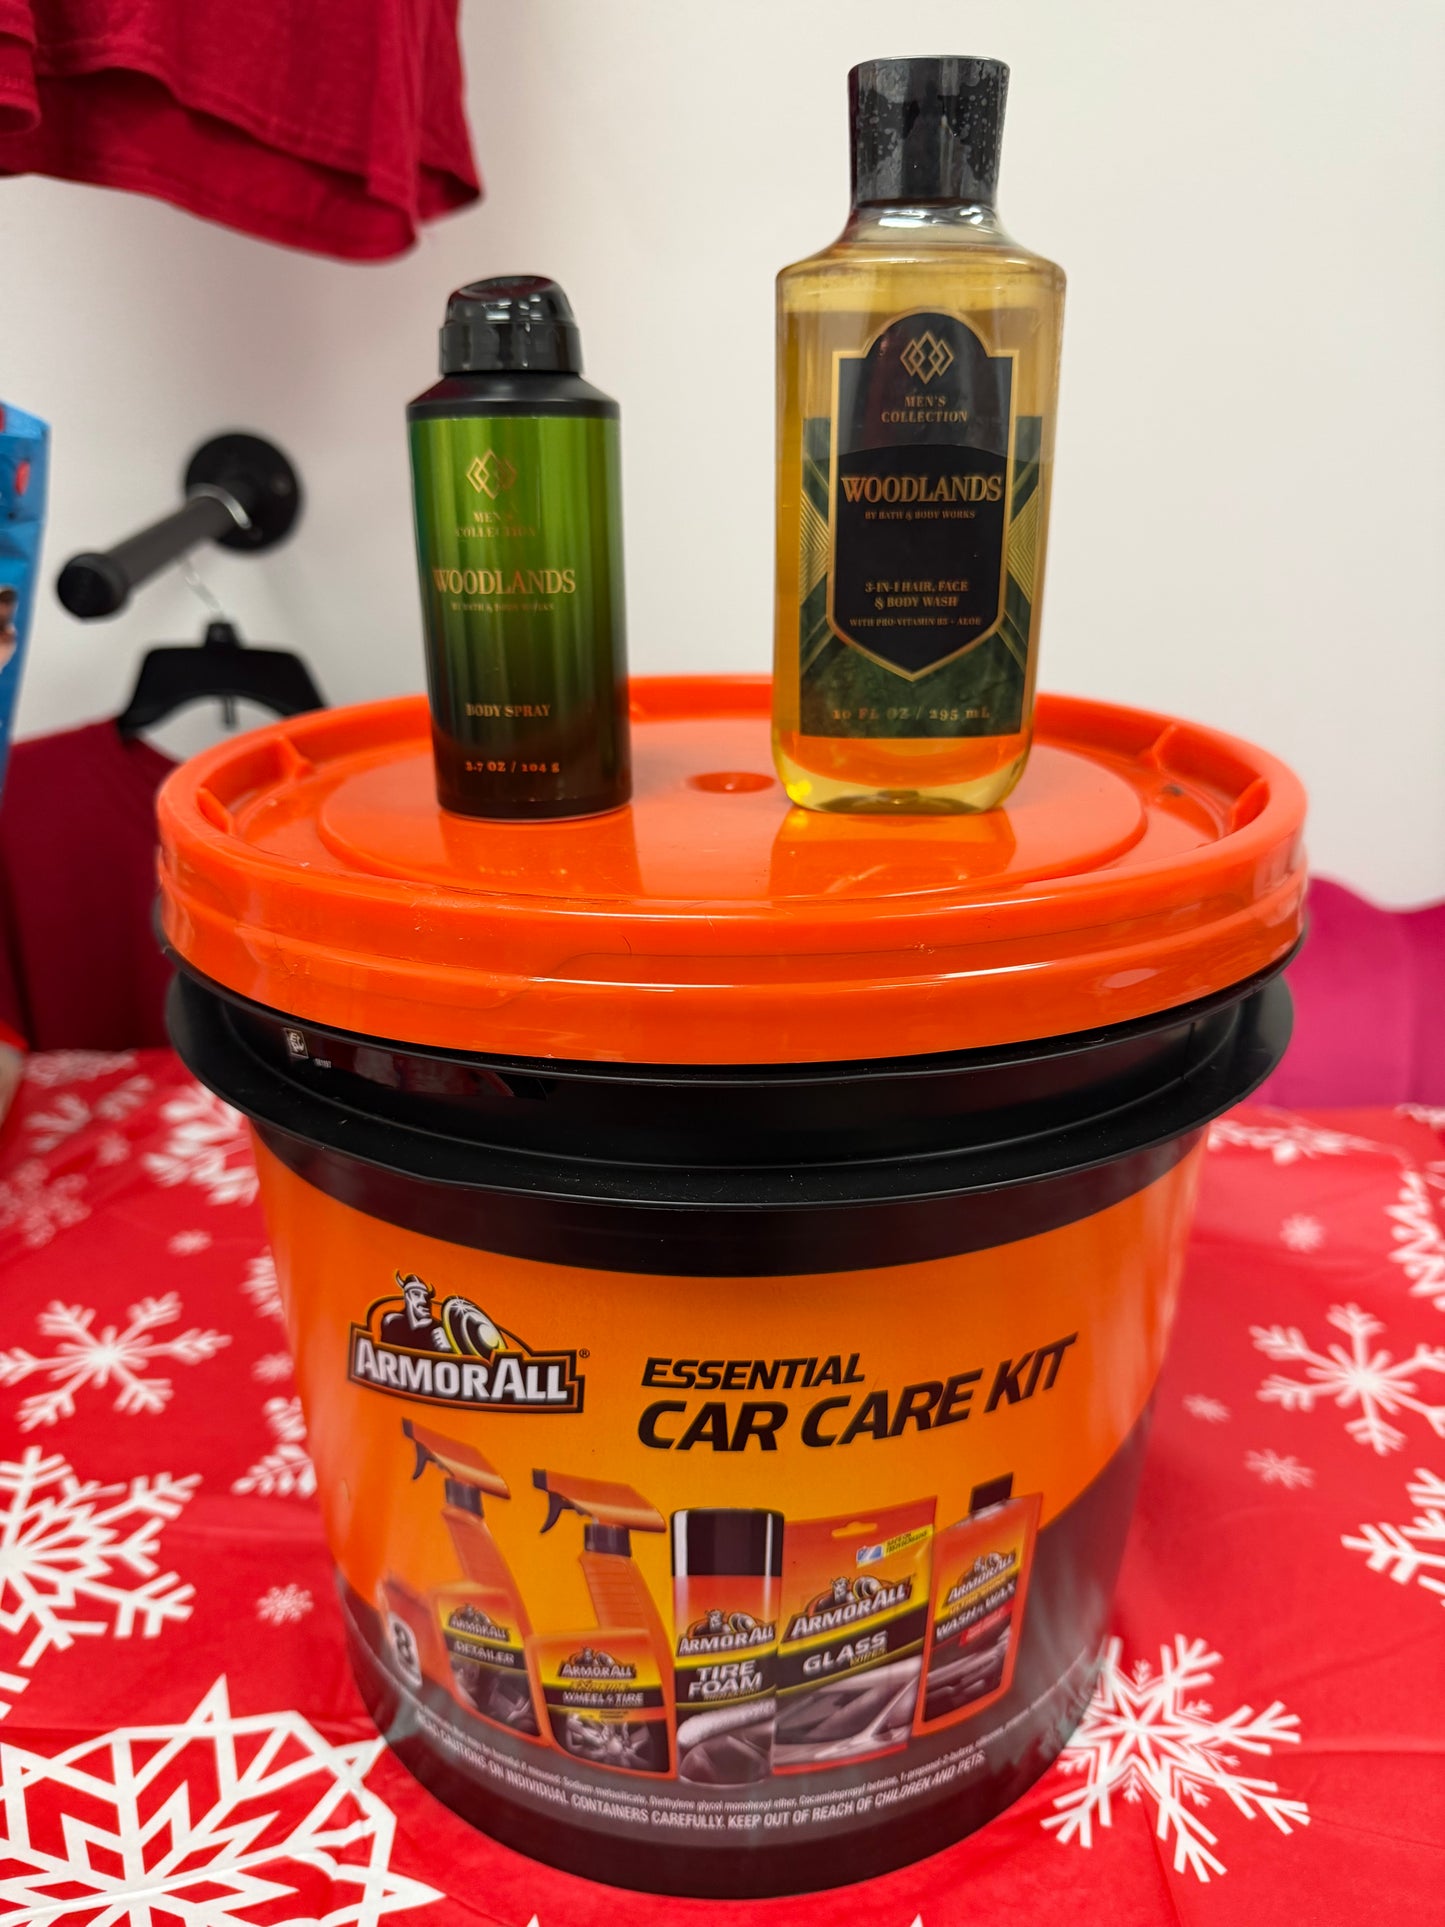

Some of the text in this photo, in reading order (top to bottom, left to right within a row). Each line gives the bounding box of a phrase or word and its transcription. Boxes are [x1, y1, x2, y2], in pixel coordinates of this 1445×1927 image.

[905, 395, 946, 408] MEN'S
[881, 410, 968, 424] COLLECTION
[841, 475, 1003, 504] WOODLANDS
[865, 511, 876, 520] BY
[879, 511, 902, 520] BATH
[914, 511, 939, 520] BODY
[942, 510, 976, 520] WORKS
[456, 526, 537, 538] COLLECTION
[432, 567, 576, 595] WOODLANDS
[864, 580, 900, 593] 3-IN-1
[938, 579, 969, 593] FACE
[874, 595, 958, 610] & BODY WASH
[849, 617, 874, 627] WITH
[957, 616, 982, 626] ALOE
[465, 703, 550, 718] BODY SPRAY
[832, 708, 852, 720] 10
[859, 707, 879, 720] FL
[886, 707, 912, 720] OZ
[929, 708, 960, 721] 295
[964, 707, 992, 720] mL
[487, 760, 506, 772] OZ
[510, 760, 517, 774] /
[521, 763, 547, 774] 104
[640, 1352, 866, 1391] ESSENTIAL
[637, 1331, 1079, 1452] CAR CARE KIT
[453, 1640, 515, 1666] DETAILER
[802, 1630, 888, 1675] GLASS
[696, 1659, 756, 1682] TIRE
[688, 1671, 763, 1700] FOAM
[562, 1690, 604, 1706] WHEEL
[615, 1691, 644, 1707] TIRE
[488, 1759, 505, 1779] ON
[505, 1768, 569, 1807] INDIVIDUAL
[571, 1792, 649, 1824] CONTAINERS
[728, 1814, 762, 1830] KEEP
[763, 1811, 791, 1828] OUT
[792, 1808, 811, 1824] OF
[811, 1799, 856, 1823] REACH
[856, 1794, 875, 1814] OF
[874, 1778, 932, 1808] CHILDREN
[931, 1766, 956, 1787] AND
